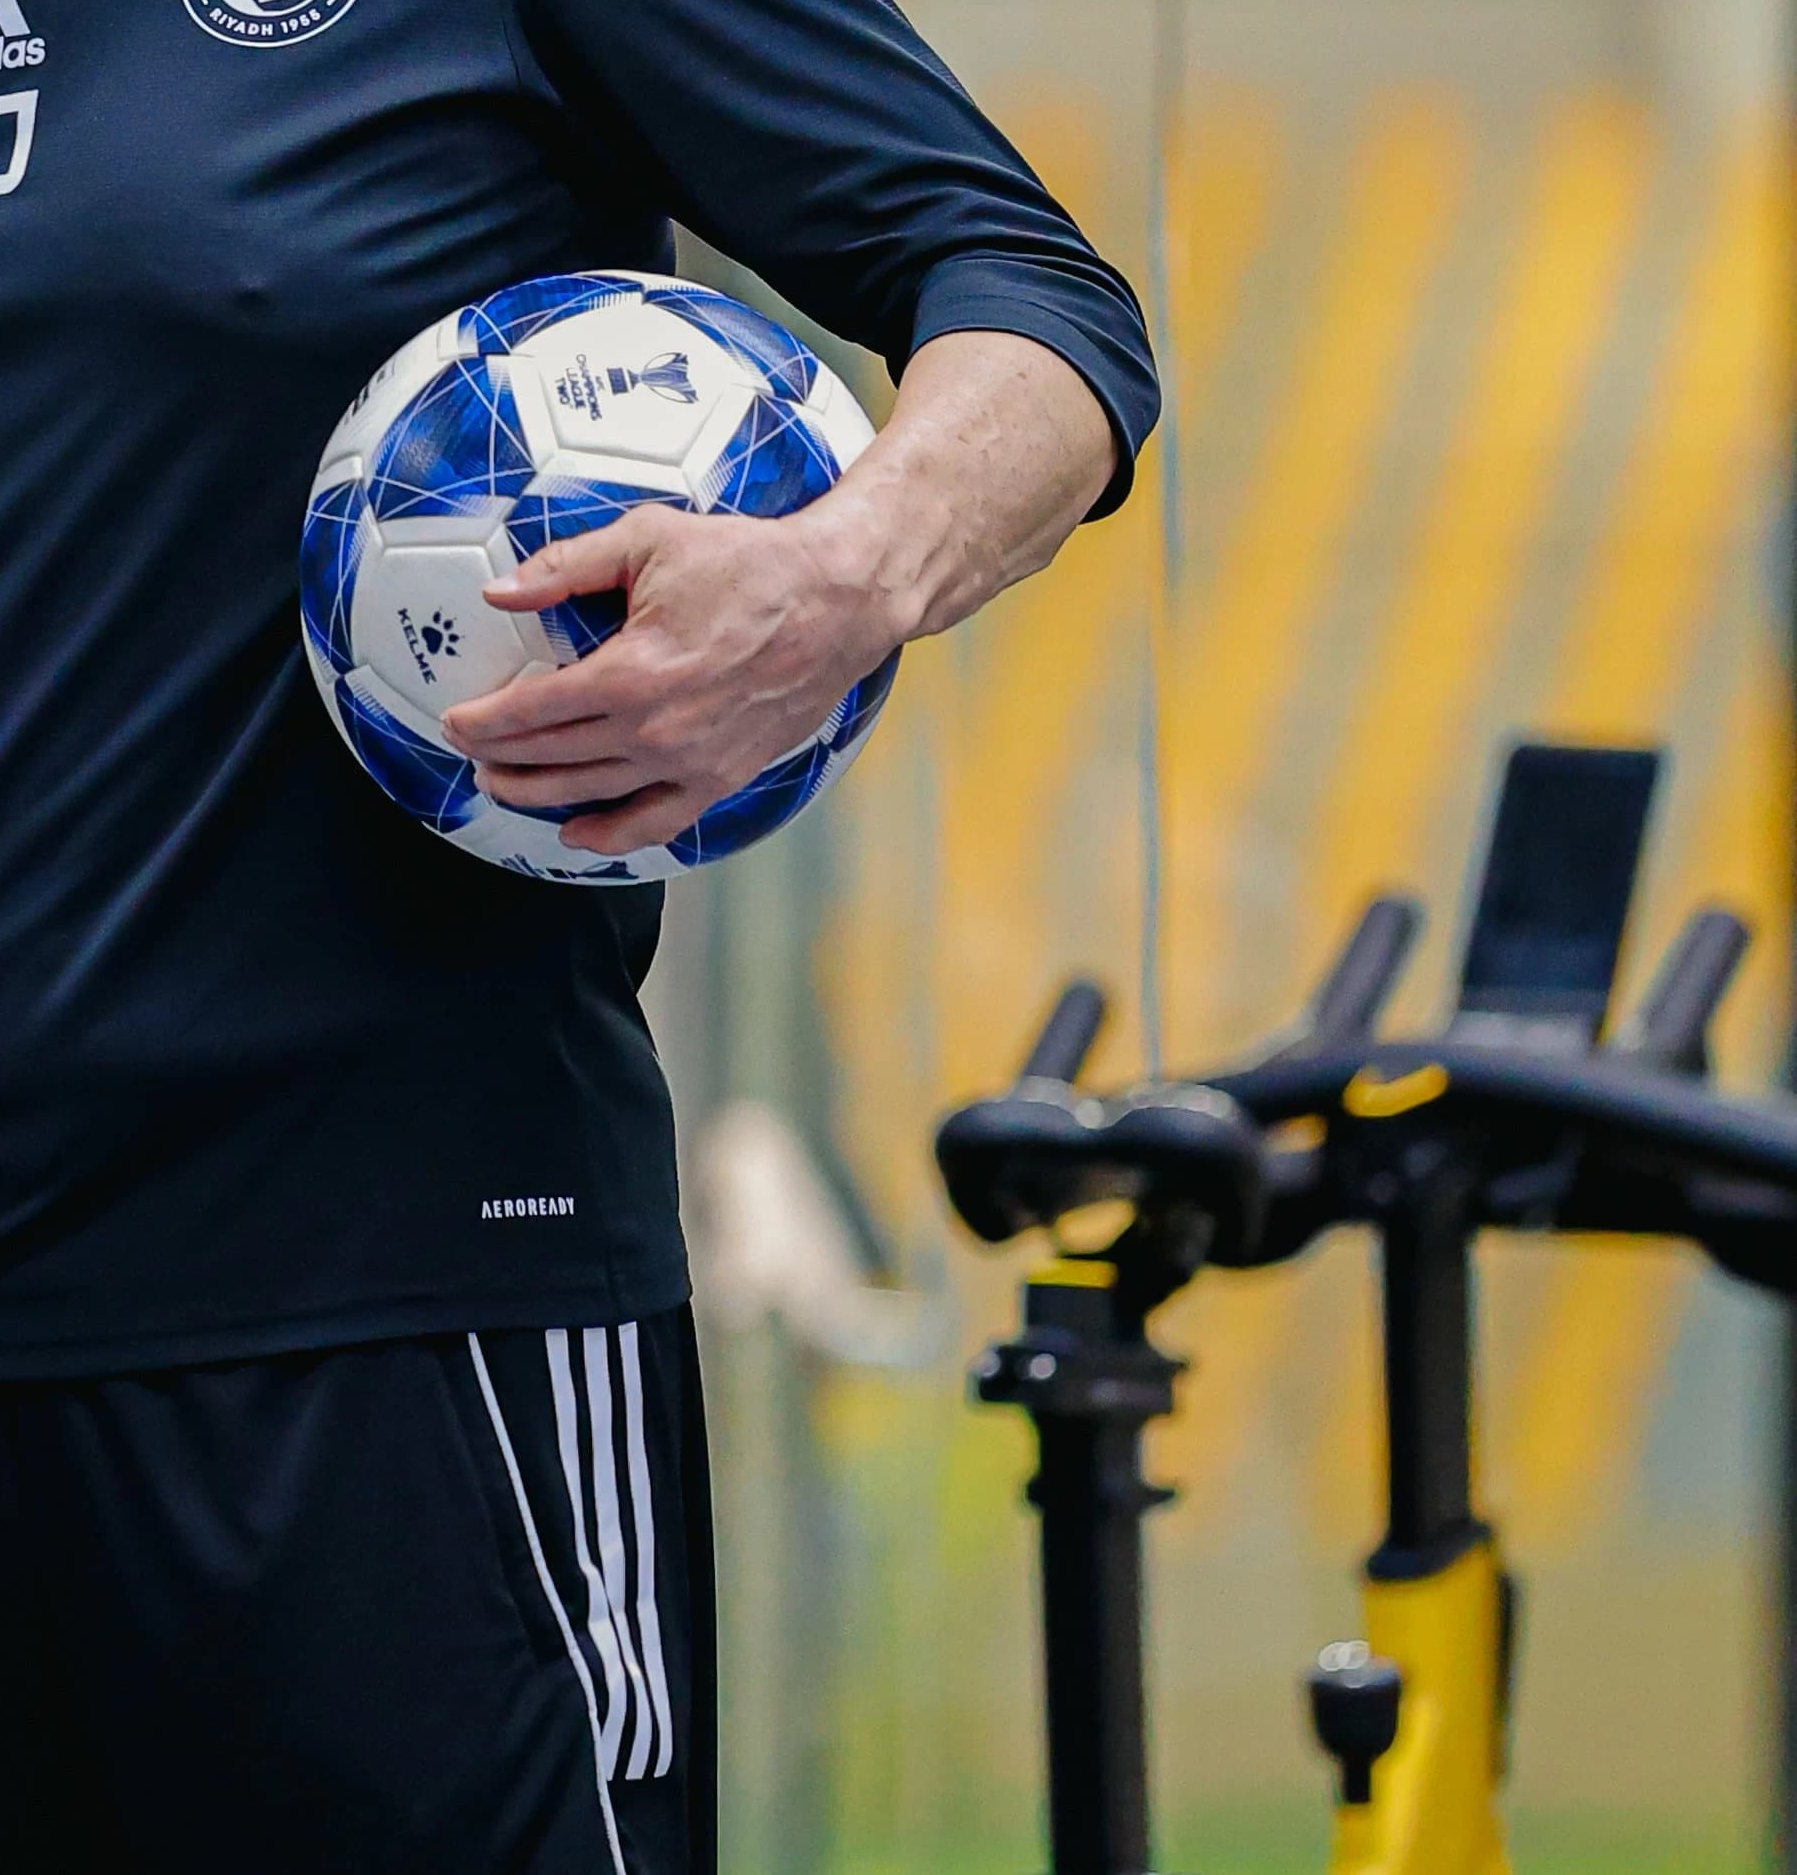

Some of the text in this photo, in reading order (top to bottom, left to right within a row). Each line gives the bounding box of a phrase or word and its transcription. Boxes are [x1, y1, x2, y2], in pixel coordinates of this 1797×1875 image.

[209, 7, 322, 36] RIYADH 1955
[396, 607, 438, 686] KELME
[481, 1196, 575, 1220] AEROREADY
